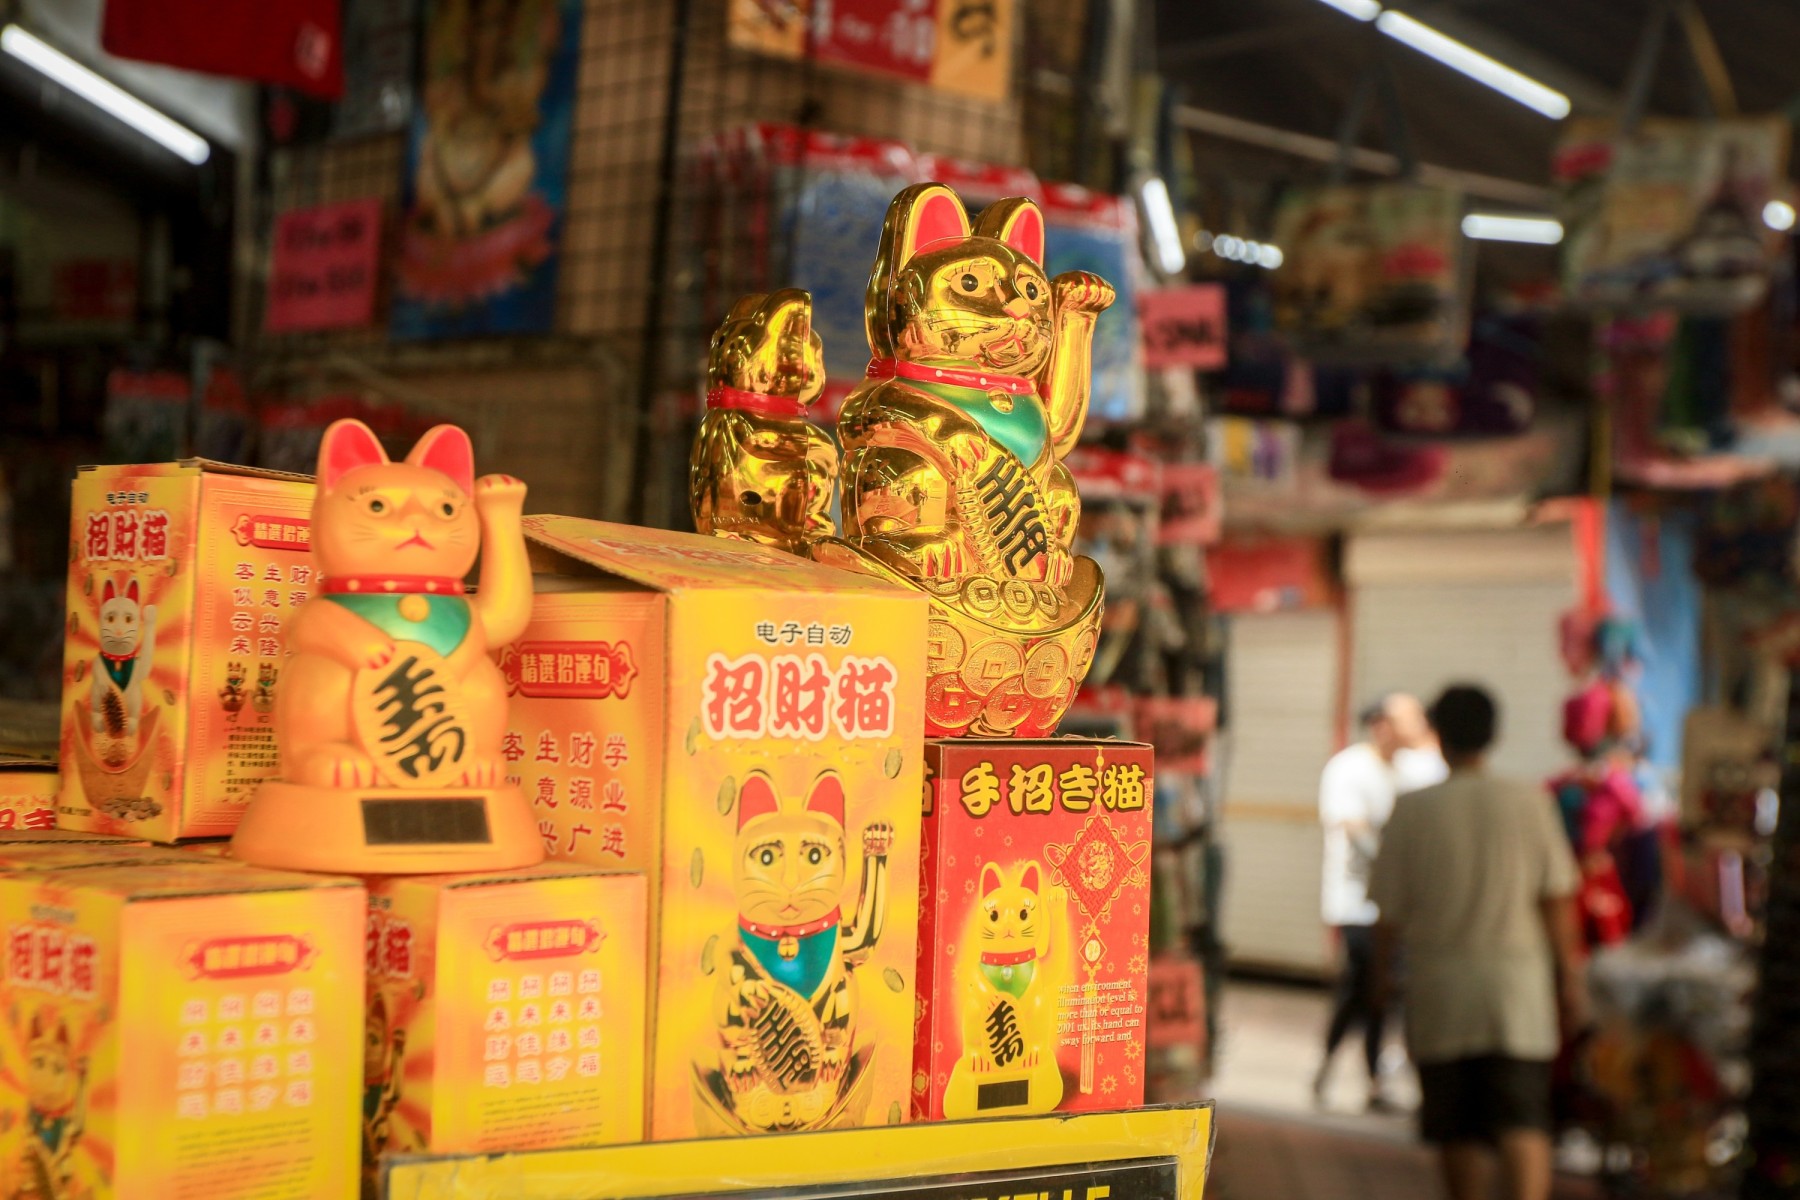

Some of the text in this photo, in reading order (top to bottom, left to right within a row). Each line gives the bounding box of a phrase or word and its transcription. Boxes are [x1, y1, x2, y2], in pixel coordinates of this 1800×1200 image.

[756, 621, 853, 645] 电子自动
[704, 656, 896, 738] 招財猫
[960, 760, 1147, 818] 手招き猫
[1058, 980, 1132, 994] when environment
[1058, 993, 1105, 1007] illumination
[1107, 992, 1126, 1003] level
[1057, 1004, 1143, 1020] more than or equal to
[1103, 1019, 1123, 1030] hand
[1125, 1018, 1140, 1028] can
[1060, 1030, 1132, 1048] sway forward and
